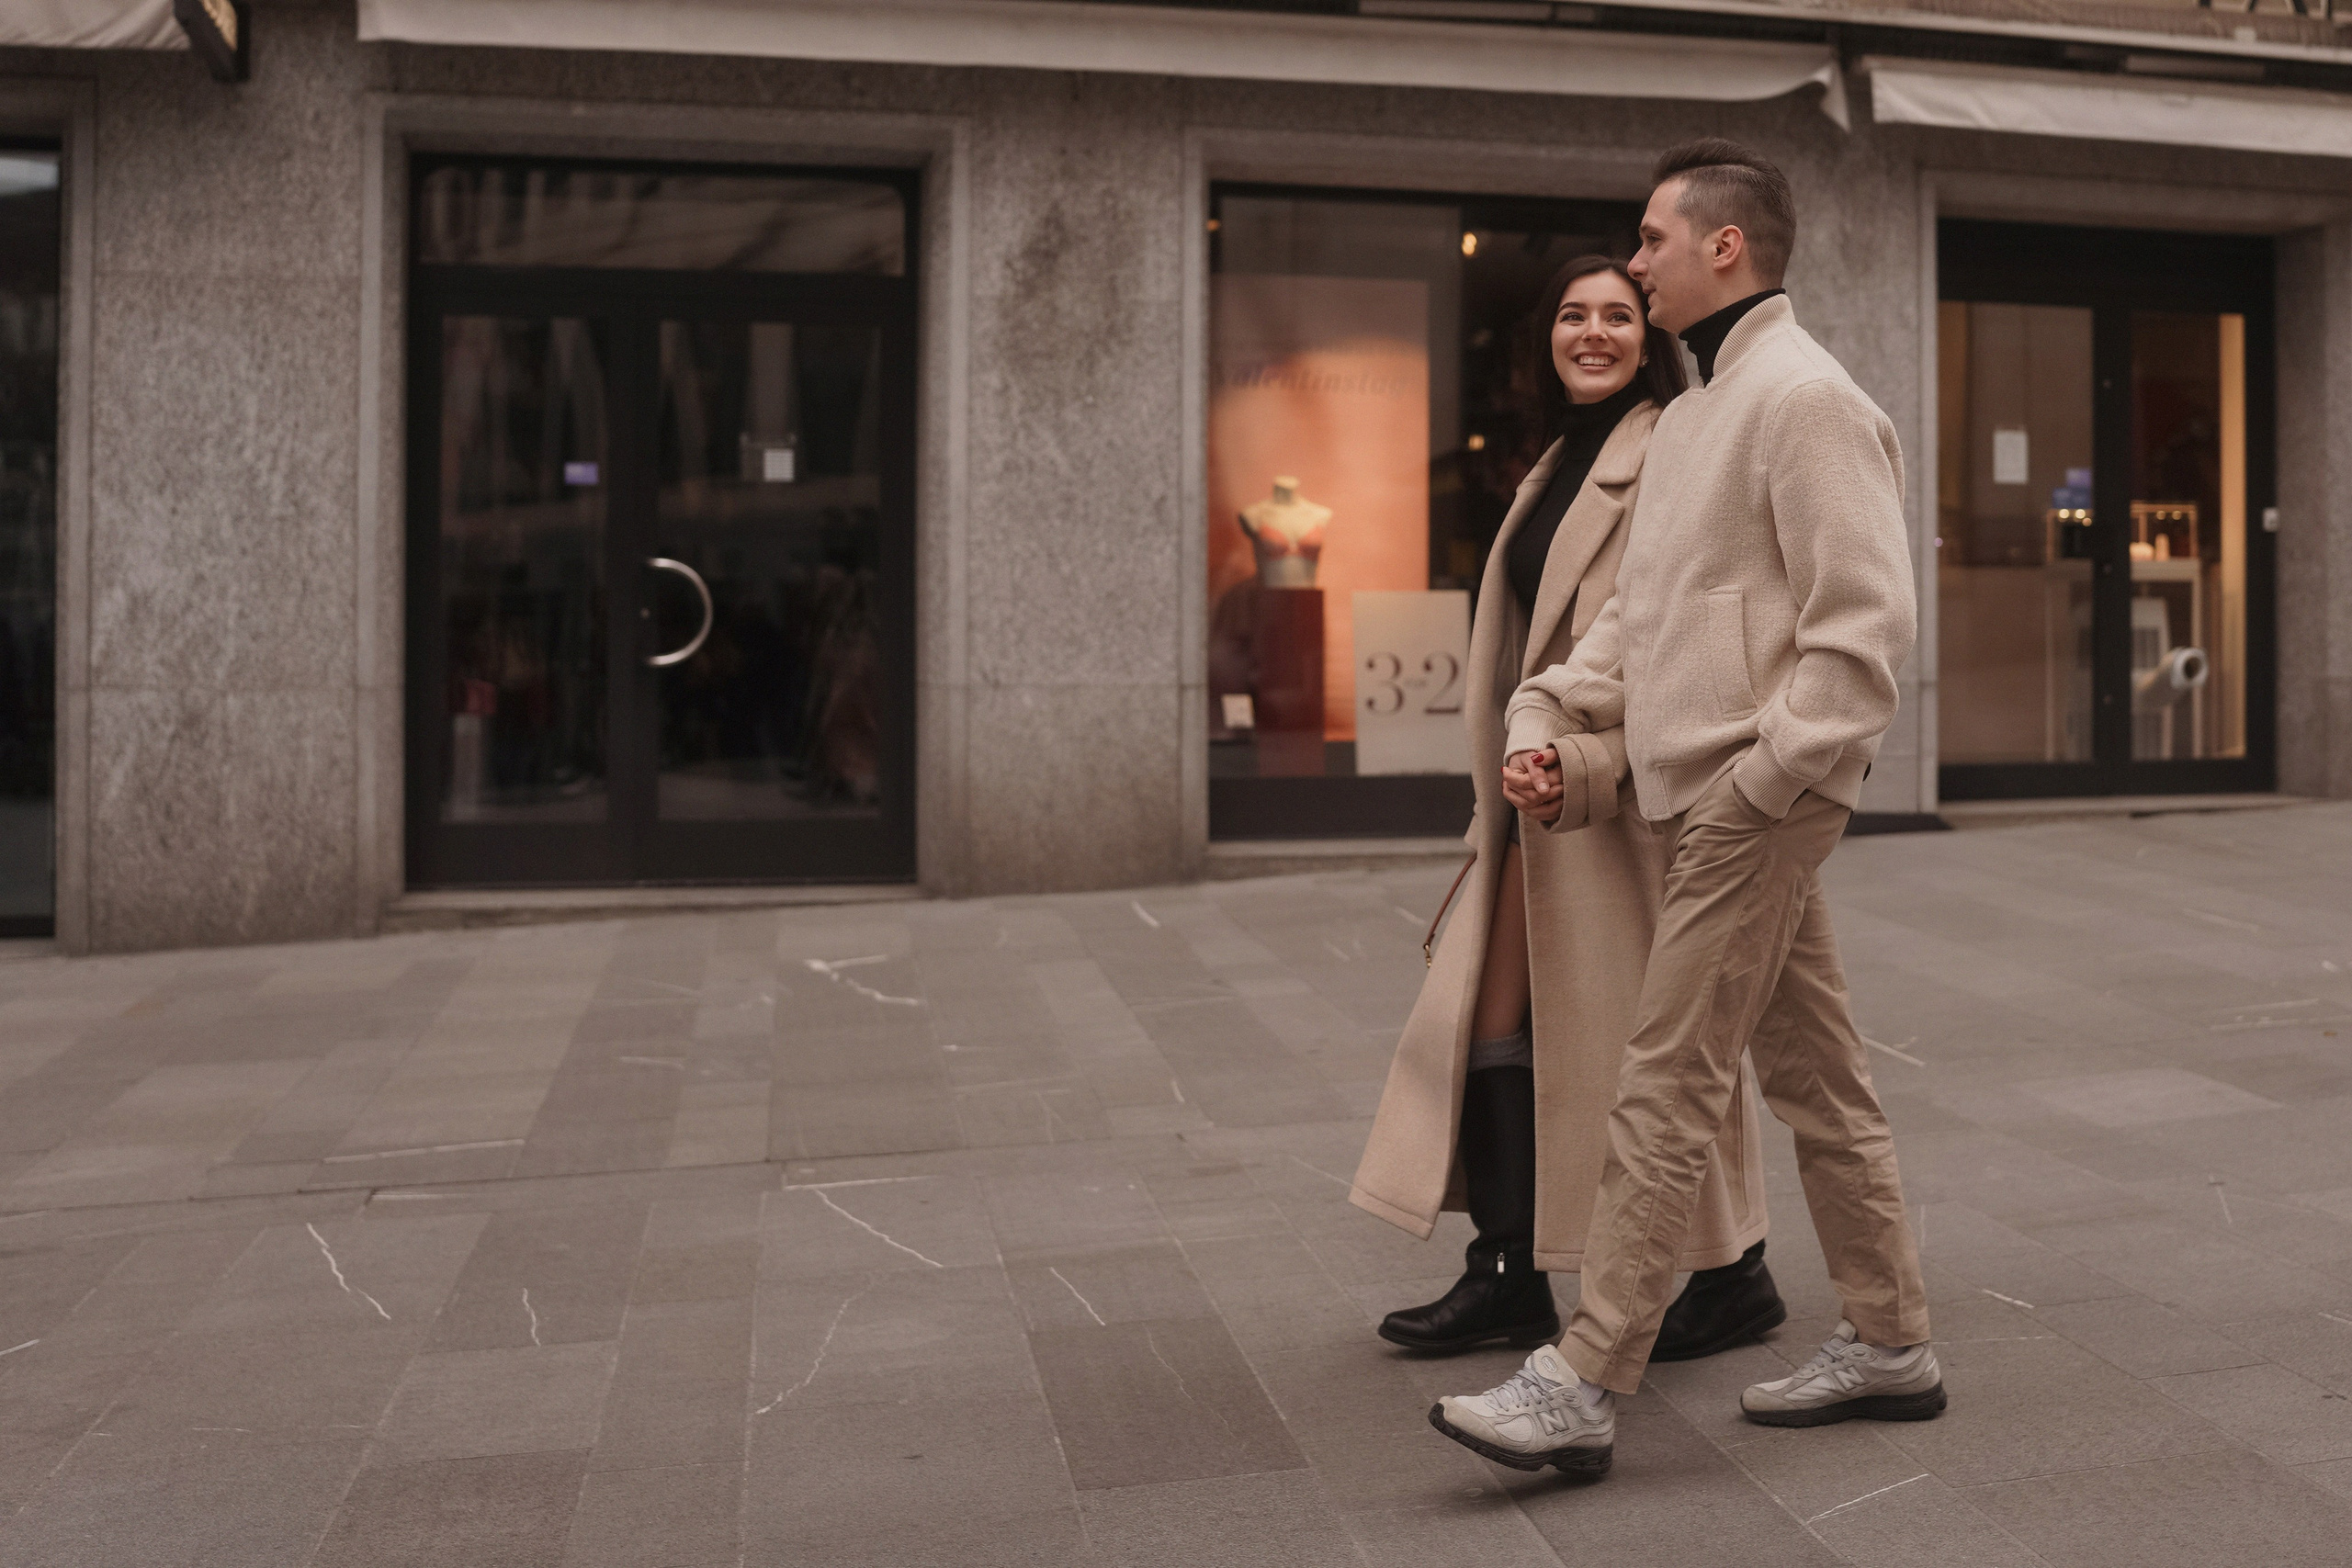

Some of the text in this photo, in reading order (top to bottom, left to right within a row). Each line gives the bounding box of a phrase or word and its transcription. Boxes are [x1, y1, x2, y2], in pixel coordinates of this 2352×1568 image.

[1364, 649, 1463, 716] 3 2
[1832, 1364, 1871, 1392] N
[1535, 1407, 1570, 1437] N
